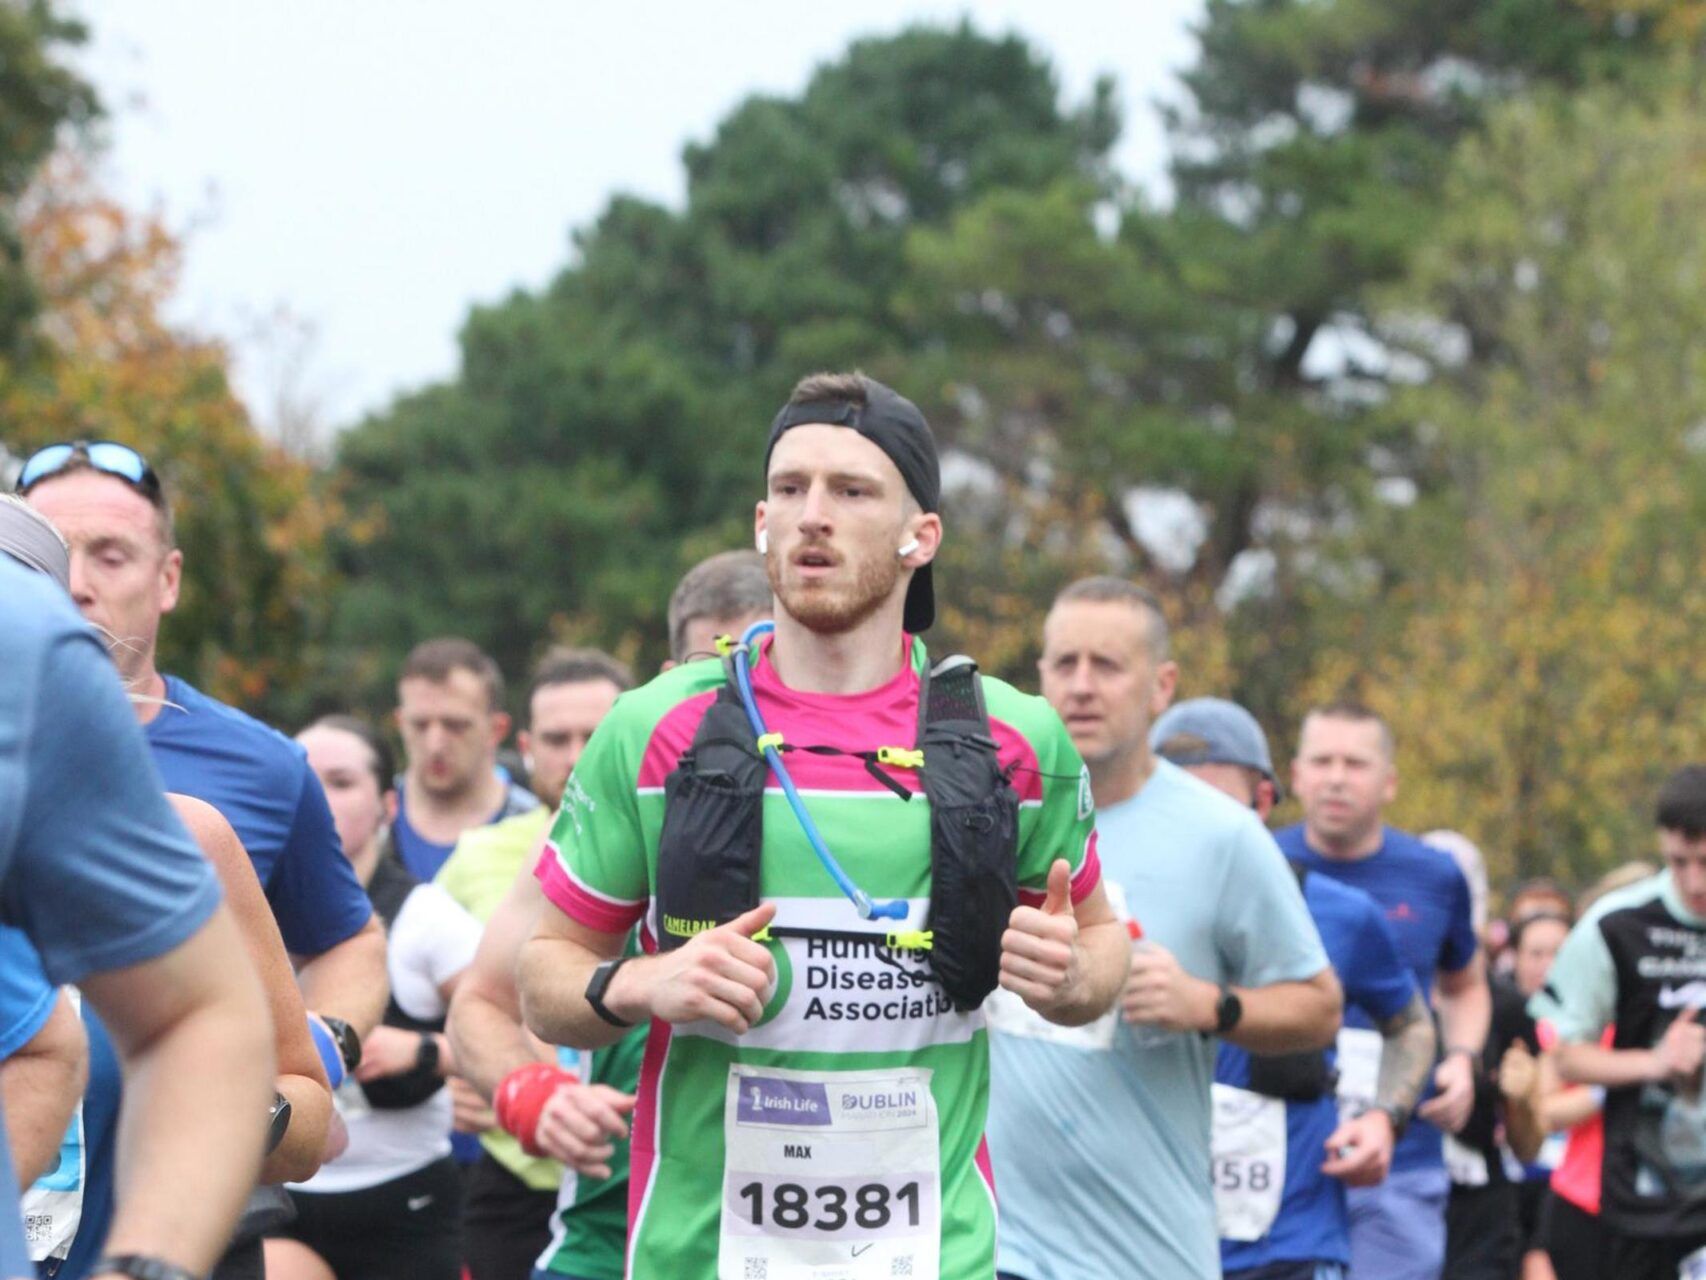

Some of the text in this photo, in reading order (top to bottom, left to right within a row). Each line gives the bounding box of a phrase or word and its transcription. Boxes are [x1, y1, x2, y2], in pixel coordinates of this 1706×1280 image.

[807, 965, 924, 990] Disease
[803, 991, 953, 1021] Associatio
[764, 1096, 818, 1113] Irish Life
[842, 1091, 916, 1110] DUBLIN
[784, 1145, 811, 1159] MAX
[740, 1181, 919, 1231] 18381
